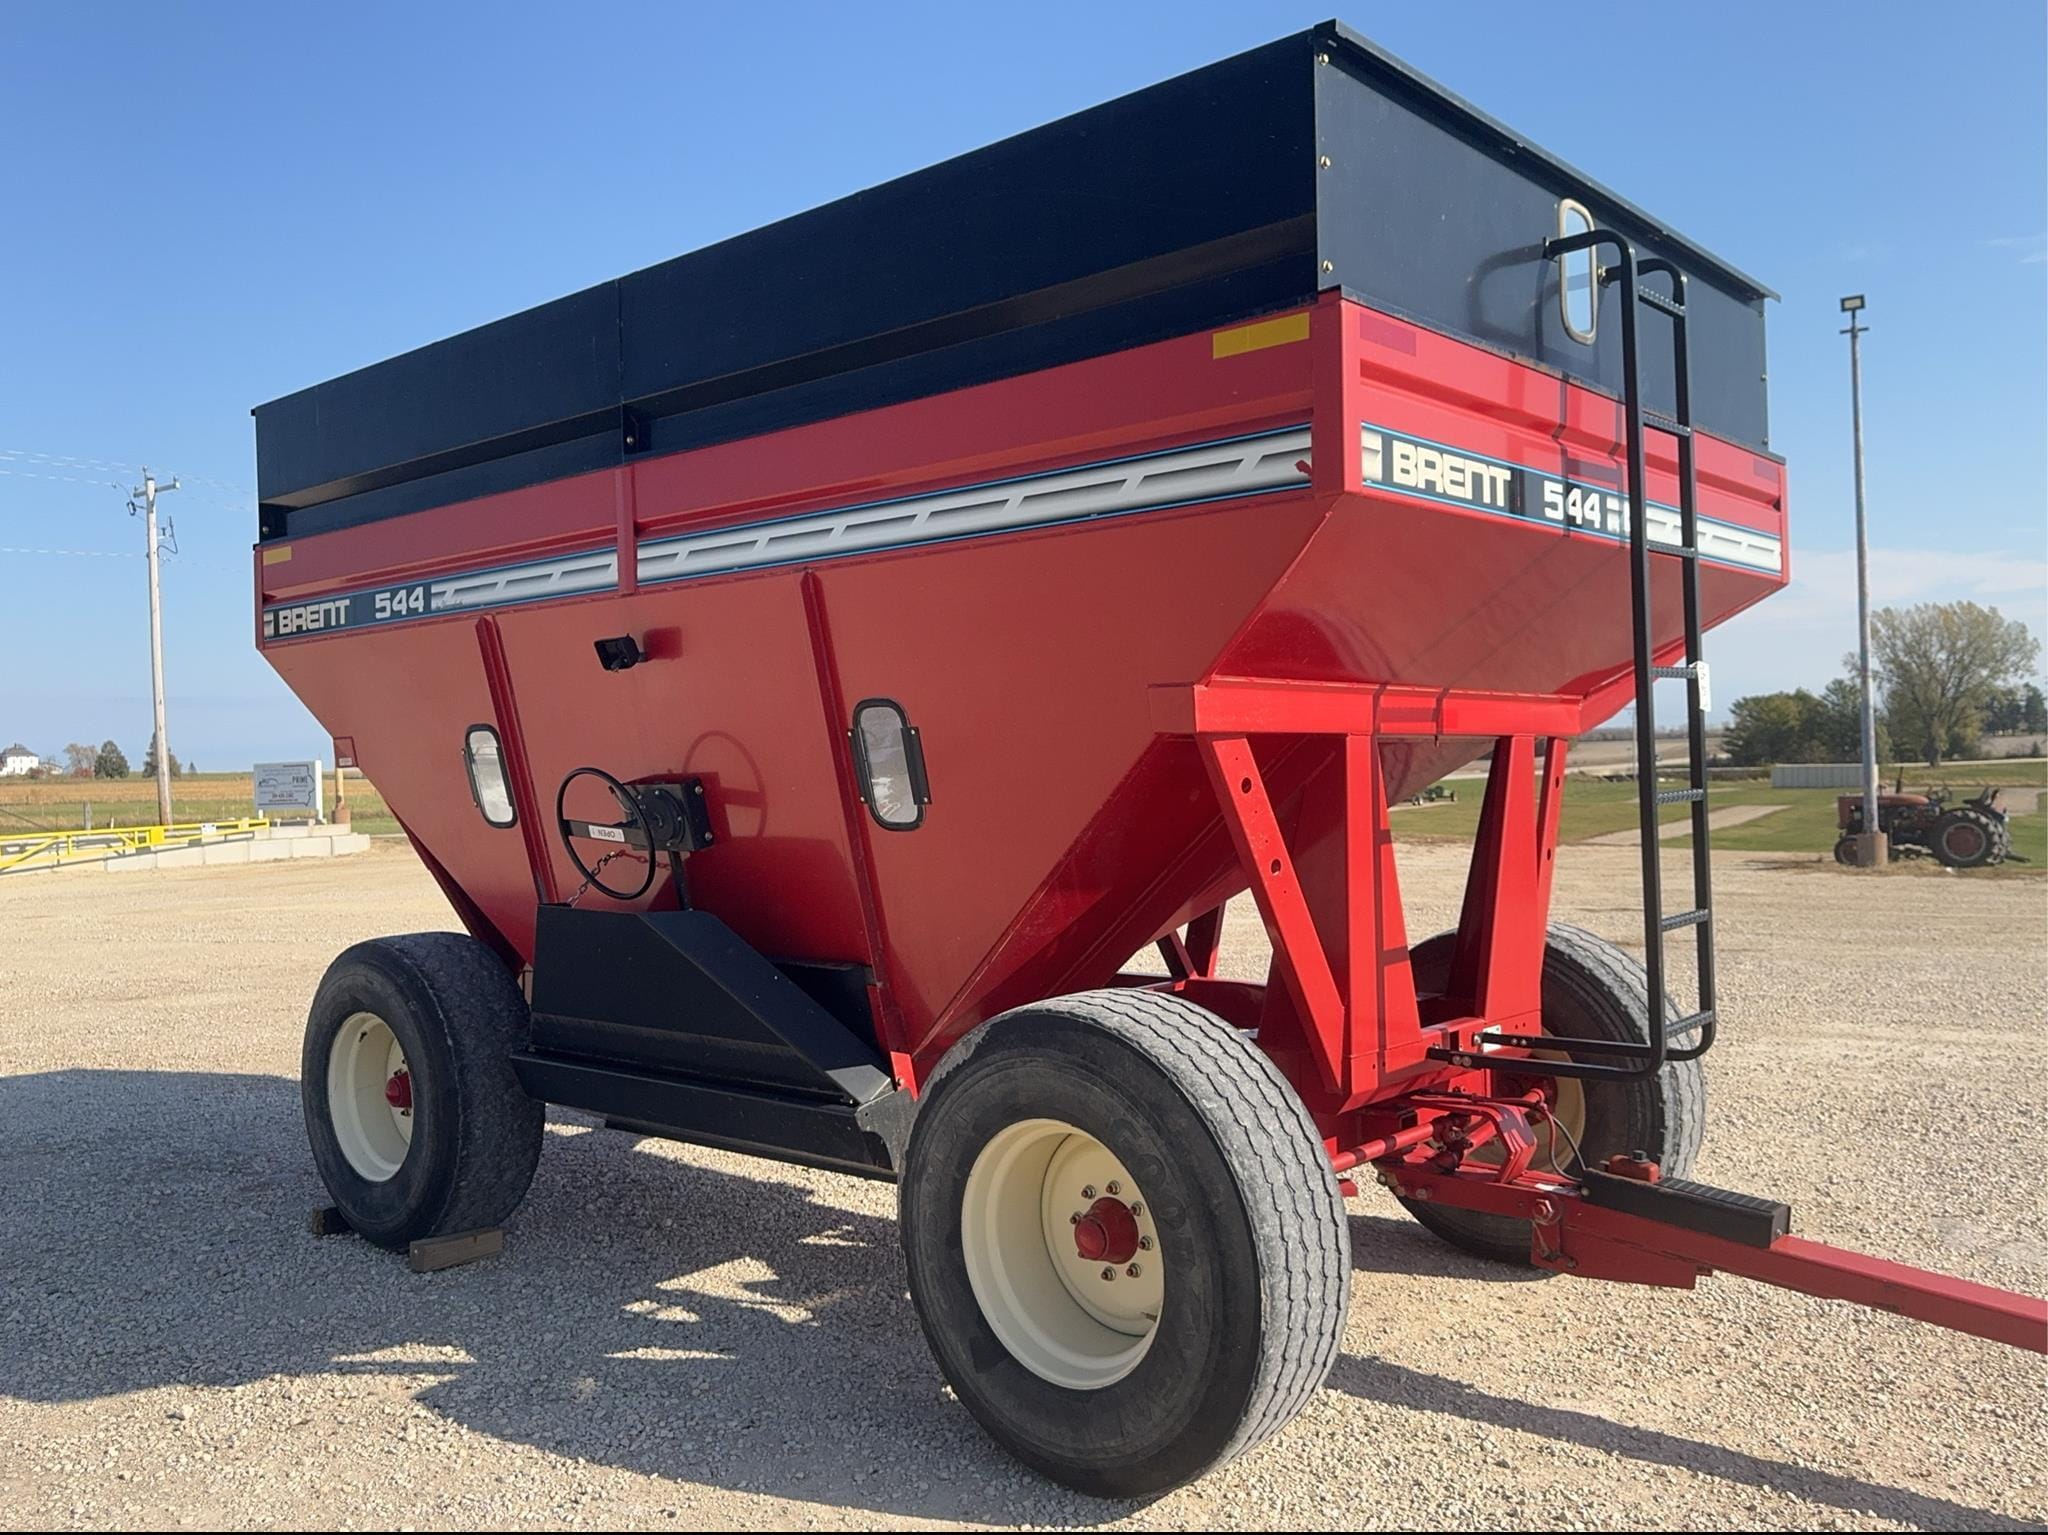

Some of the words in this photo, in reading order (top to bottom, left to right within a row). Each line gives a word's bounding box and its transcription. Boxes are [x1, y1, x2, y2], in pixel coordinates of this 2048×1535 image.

[1391, 440, 1511, 507] BRENT
[1543, 480, 1601, 528] 544
[279, 598, 351, 635] BRENT
[375, 586, 424, 619] 544
